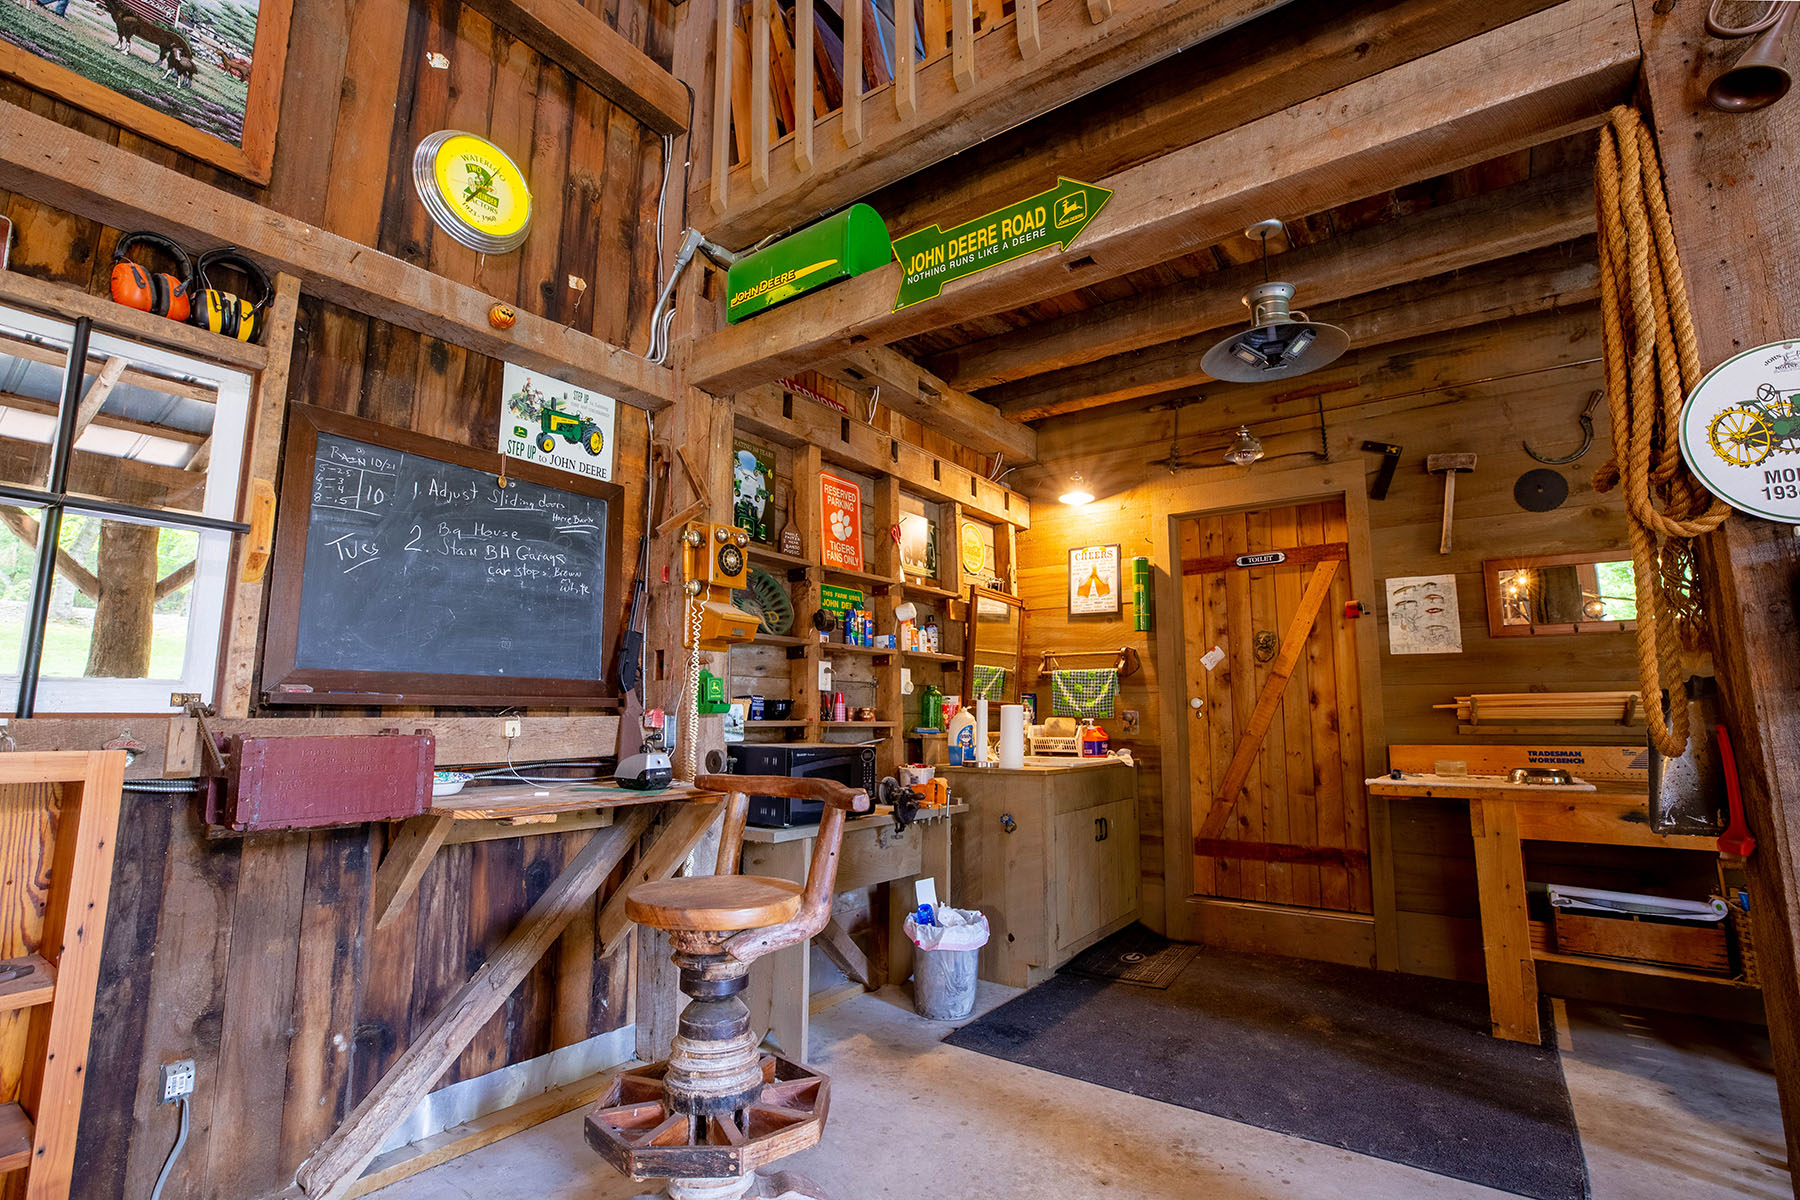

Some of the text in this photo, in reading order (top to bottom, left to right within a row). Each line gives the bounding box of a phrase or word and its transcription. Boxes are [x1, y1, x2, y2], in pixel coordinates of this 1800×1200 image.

[467, 164, 482, 174] TWO
[907, 206, 1047, 276] JOHN DEERE ROAD
[907, 227, 1046, 285] NOTHING RUNS LIKE A DEERE
[1764, 354, 1782, 366] JOHN
[506, 439, 607, 479] STEP UP to JOHN DEERE
[428, 478, 479, 504] Adjust
[824, 484, 857, 503] RESERVED
[1761, 484, 1800, 501] 193
[827, 495, 854, 512] PARKING
[474, 522, 521, 541] House
[829, 540, 856, 556] TIGERS
[1074, 550, 1113, 561] CHEERS
[826, 550, 859, 567] FANS ONLY
[1248, 555, 1273, 563] TOILET
[822, 599, 839, 608] JOHN
